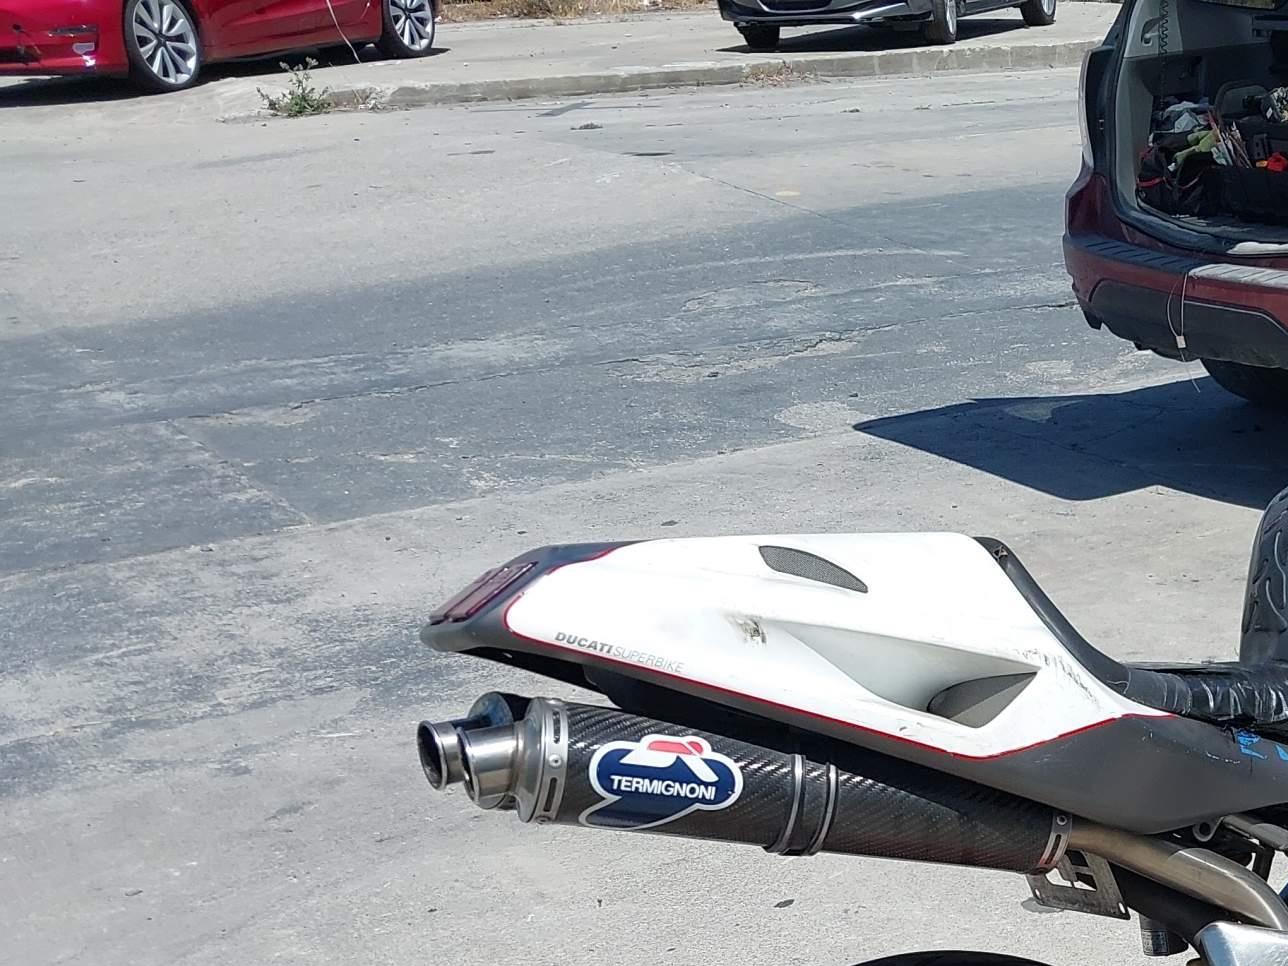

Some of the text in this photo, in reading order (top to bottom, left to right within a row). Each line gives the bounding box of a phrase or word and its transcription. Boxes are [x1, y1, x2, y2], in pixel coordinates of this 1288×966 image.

[555, 632, 685, 673] DUCATI SUPERBIKE
[610, 775, 717, 800] TERMIGNONI
